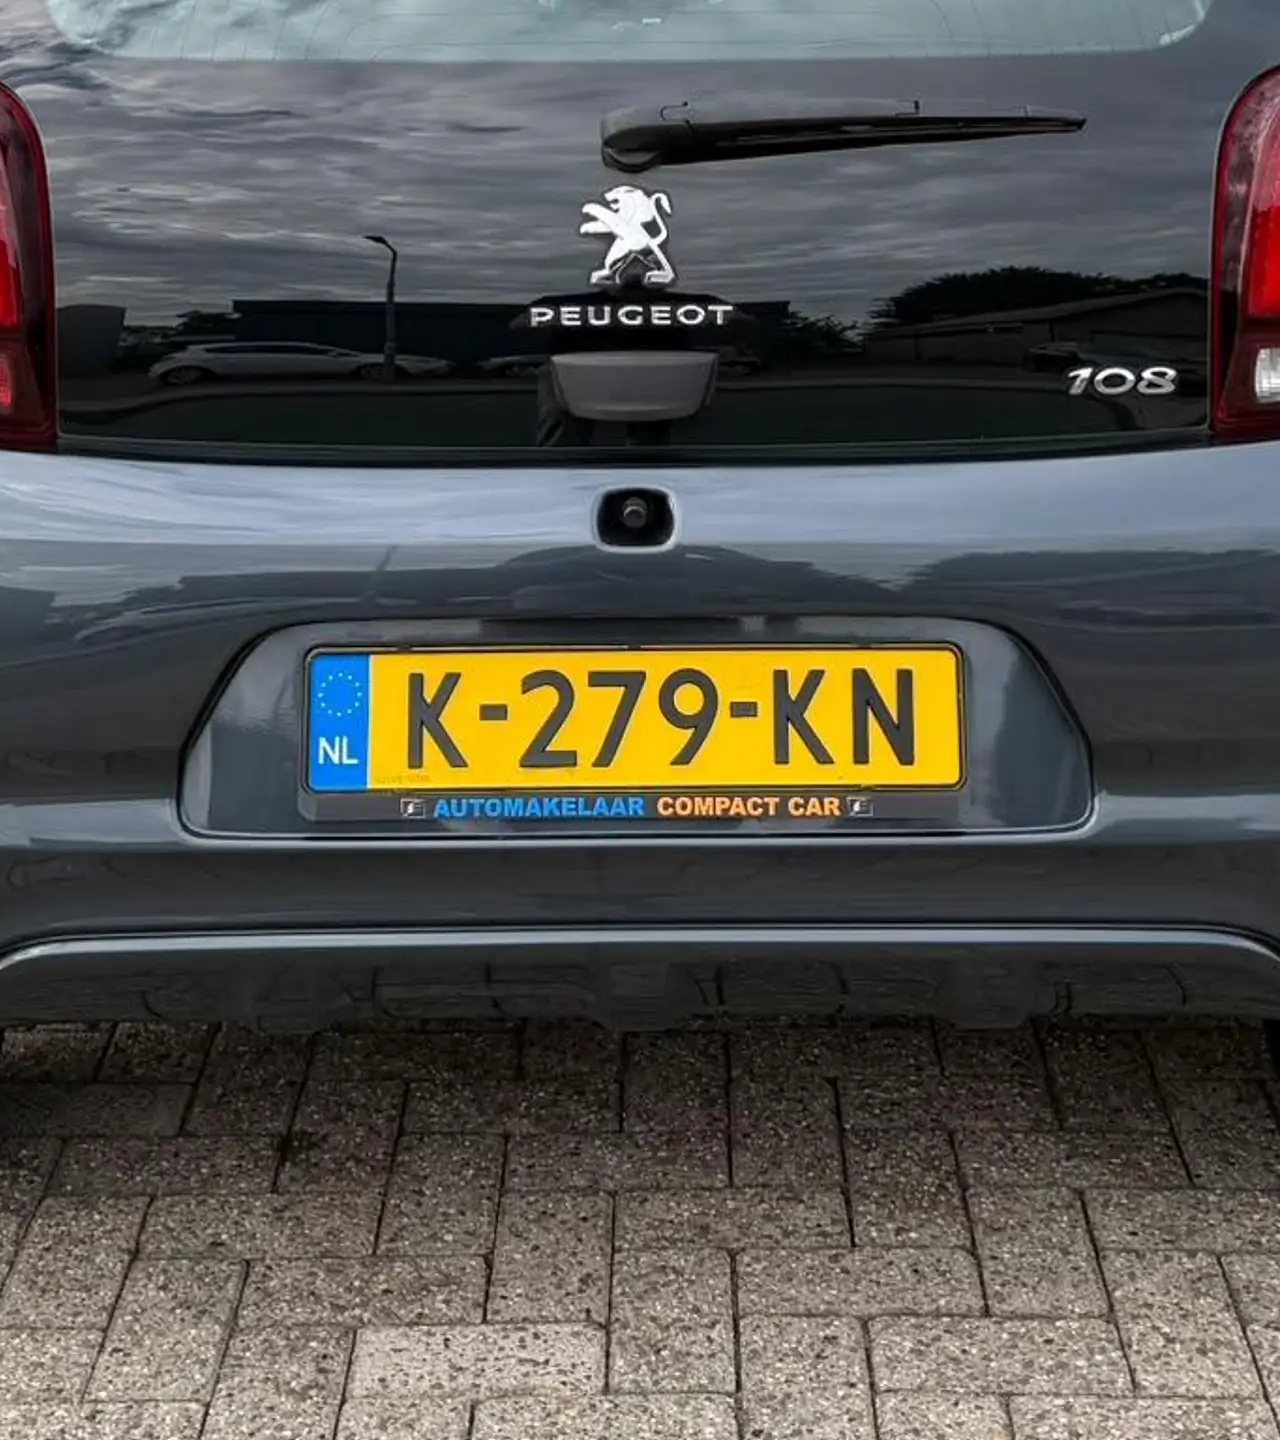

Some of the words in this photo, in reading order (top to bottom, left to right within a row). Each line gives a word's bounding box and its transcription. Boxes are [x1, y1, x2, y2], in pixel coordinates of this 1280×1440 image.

[529, 304, 732, 328] PEUGEOT
[1066, 366, 1176, 396] 108
[405, 667, 915, 770] K-279-KN
[317, 736, 360, 766] NL
[432, 796, 644, 819] AUTOMAKELAAR
[656, 796, 781, 819] COMPACT
[787, 796, 841, 819] CAR
